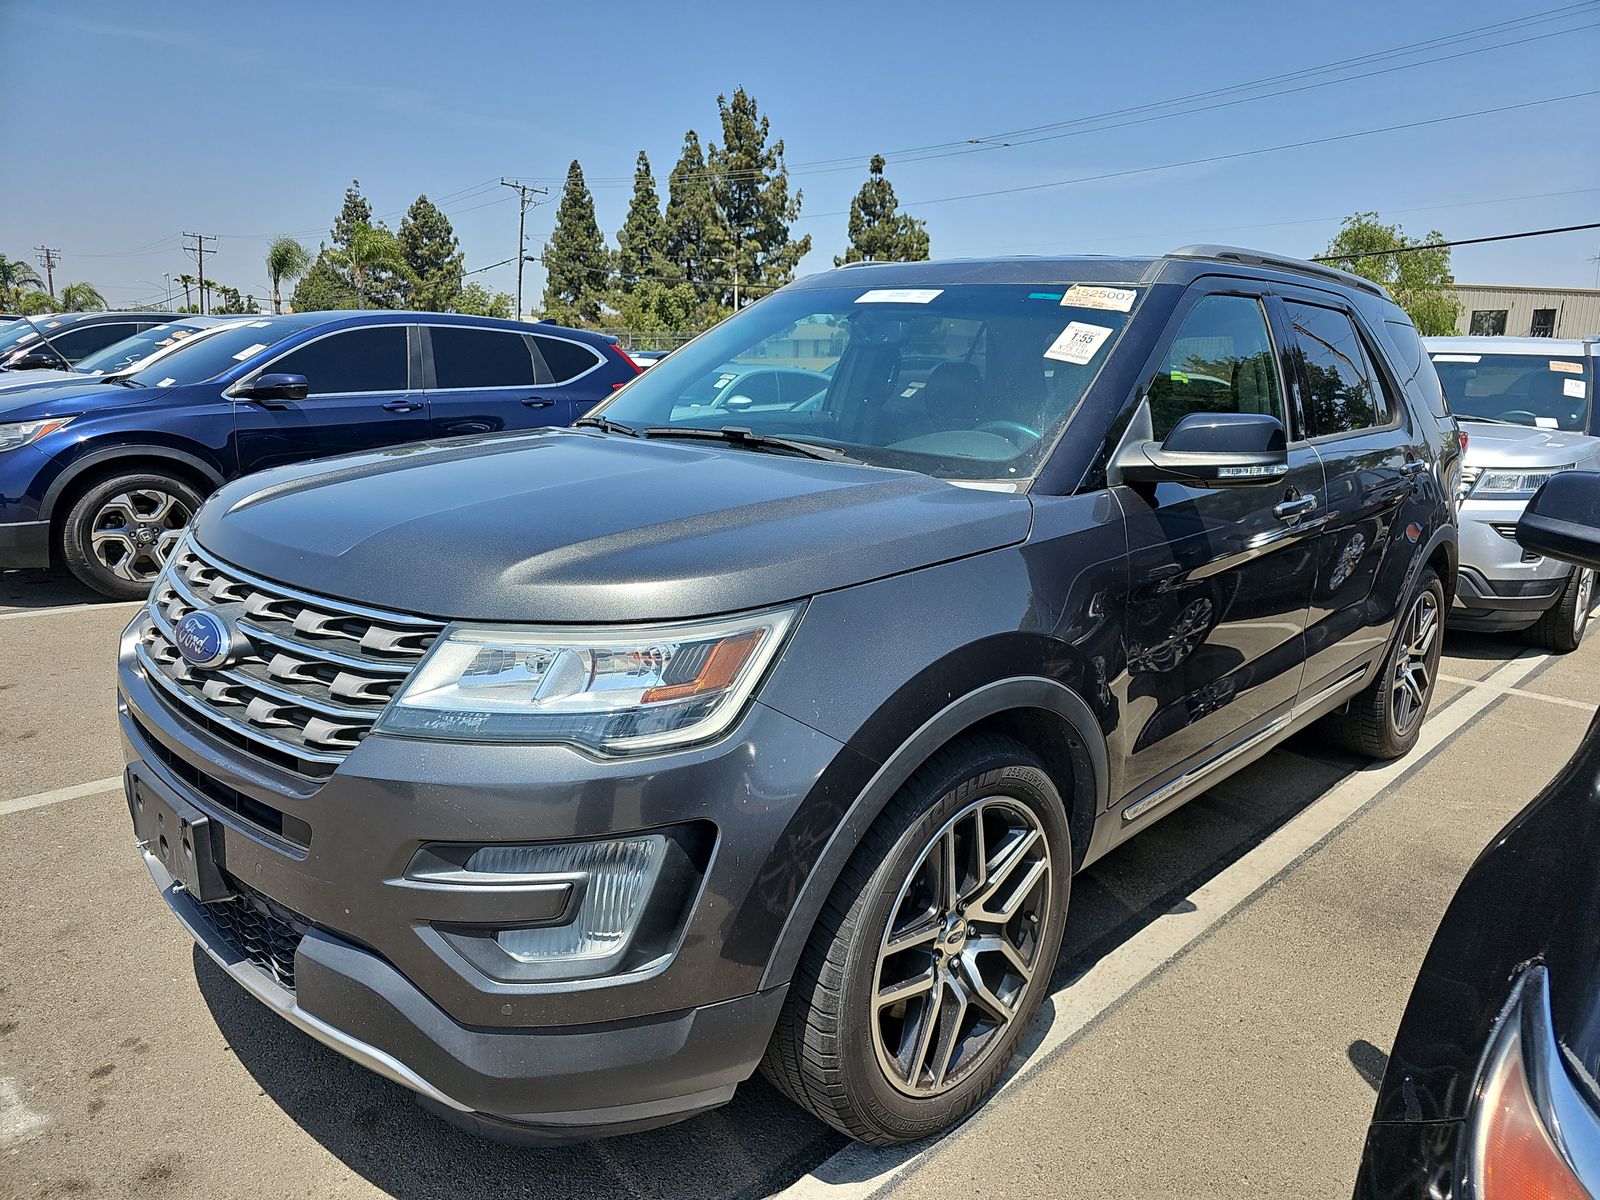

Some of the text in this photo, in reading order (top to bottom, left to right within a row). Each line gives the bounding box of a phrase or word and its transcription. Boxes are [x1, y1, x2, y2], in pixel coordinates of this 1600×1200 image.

[1071, 332, 1095, 344] 1:55
[178, 617, 210, 655] Ford
[1006, 766, 1046, 792] 255/50R20
